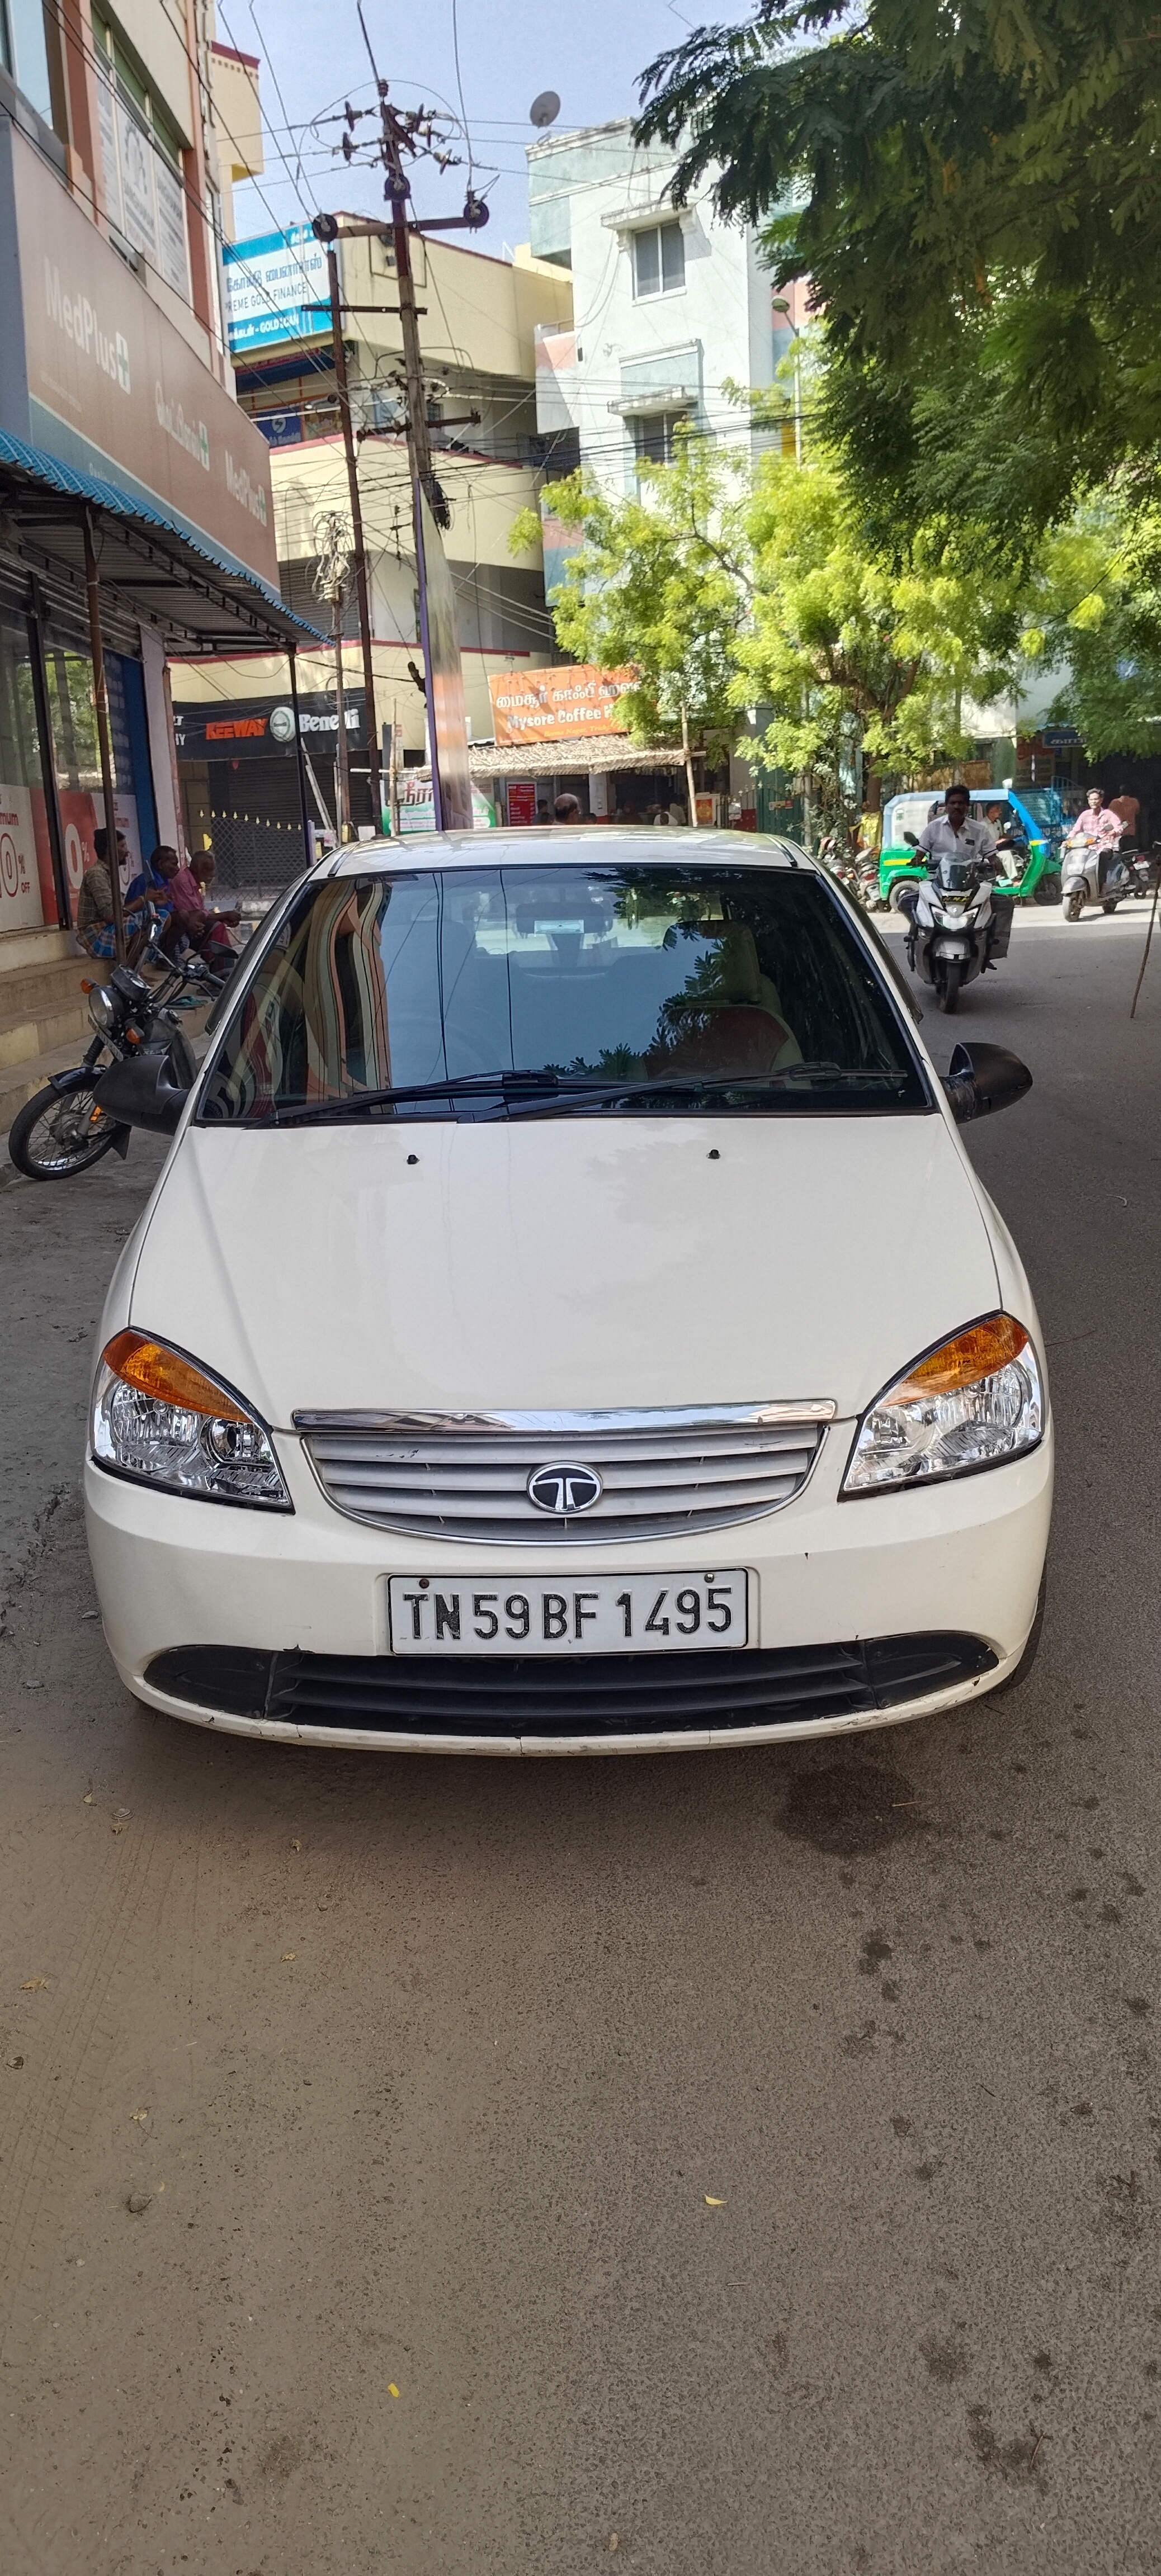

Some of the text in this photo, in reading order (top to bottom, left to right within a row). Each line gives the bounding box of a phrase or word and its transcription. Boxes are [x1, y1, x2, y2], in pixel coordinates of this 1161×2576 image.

[273, 282, 308, 301] FINANCE
[45, 255, 116, 381] MedPlus
[259, 317, 279, 333] GOLD
[225, 450, 259, 520] MedPlus
[496, 685, 549, 709] மைசூர்
[205, 718, 268, 740] KEEWAY
[507, 713, 555, 731] Mysore
[558, 707, 602, 724] Coffee
[21, 882, 30, 893] OFF
